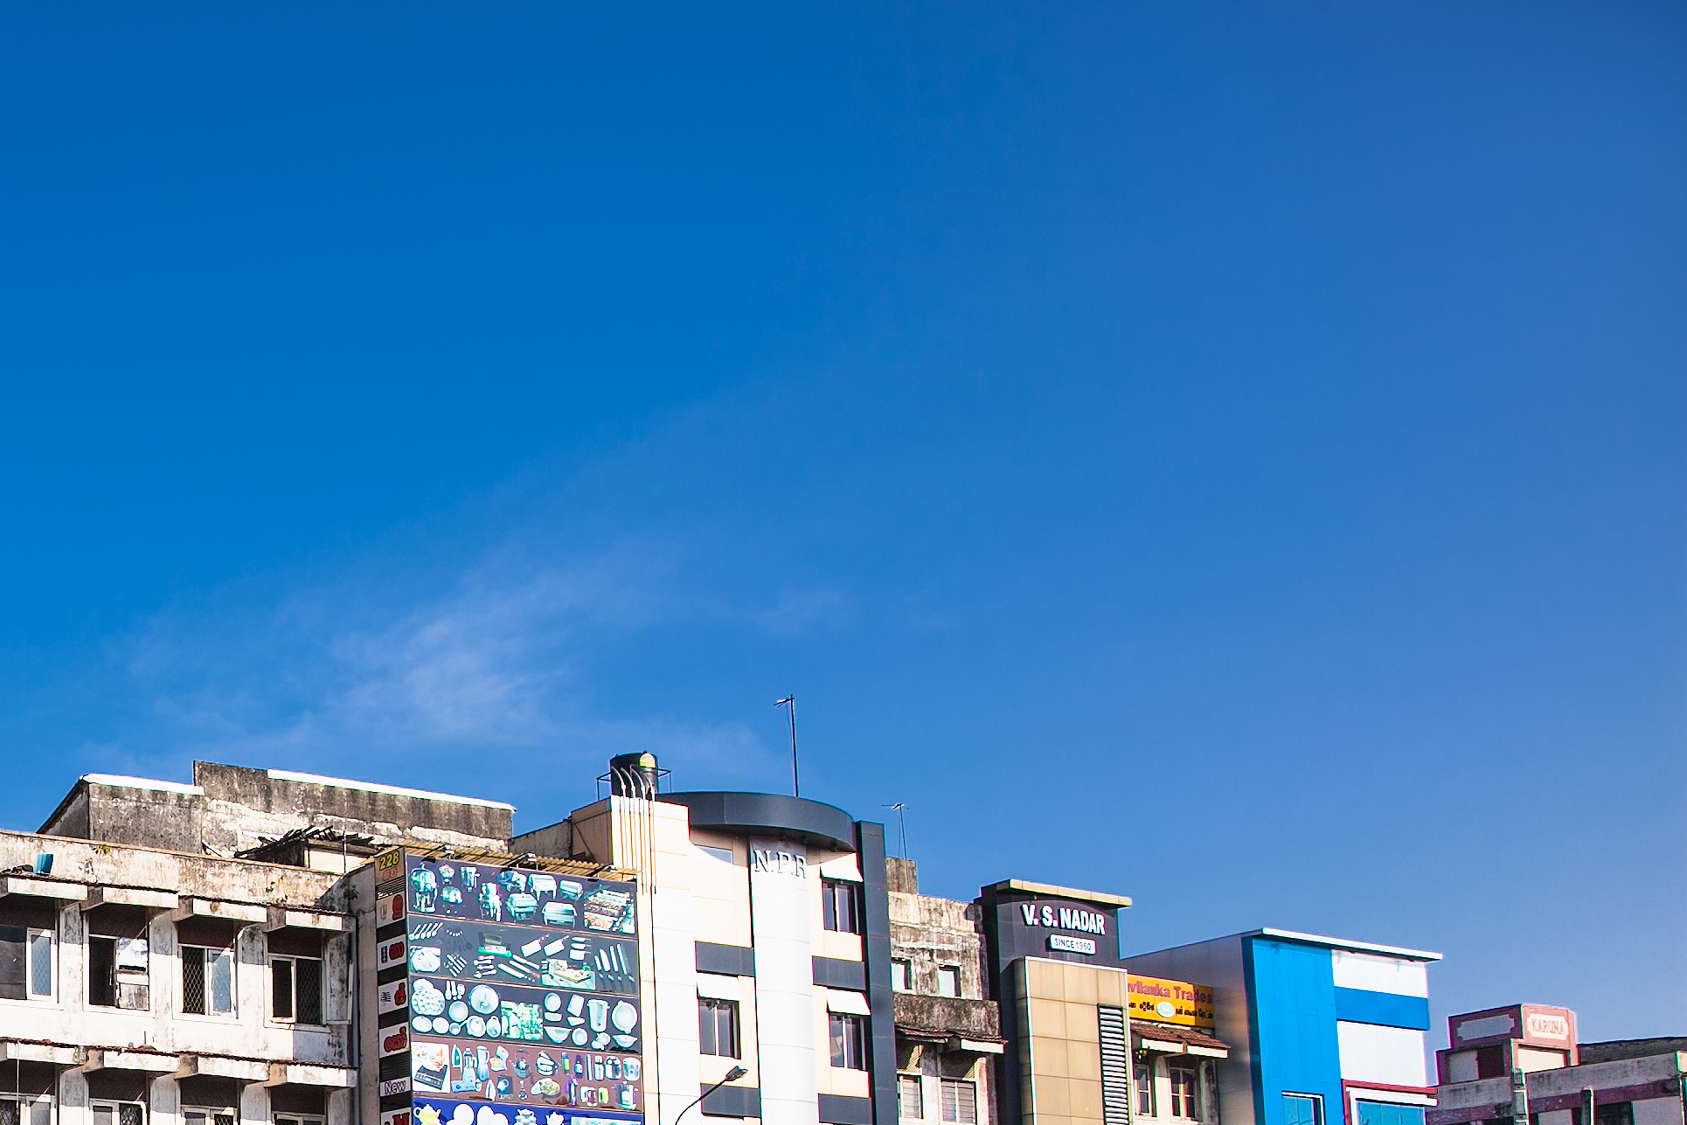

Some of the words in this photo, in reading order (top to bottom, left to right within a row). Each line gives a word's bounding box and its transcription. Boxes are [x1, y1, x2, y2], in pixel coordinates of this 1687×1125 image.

[379, 851, 400, 870] 228
[1021, 904, 1039, 927] V.
[1041, 905, 1058, 928] S.
[1059, 908, 1106, 935] NADAR
[1054, 938, 1074, 949] SINCE
[384, 1080, 407, 1096] New
